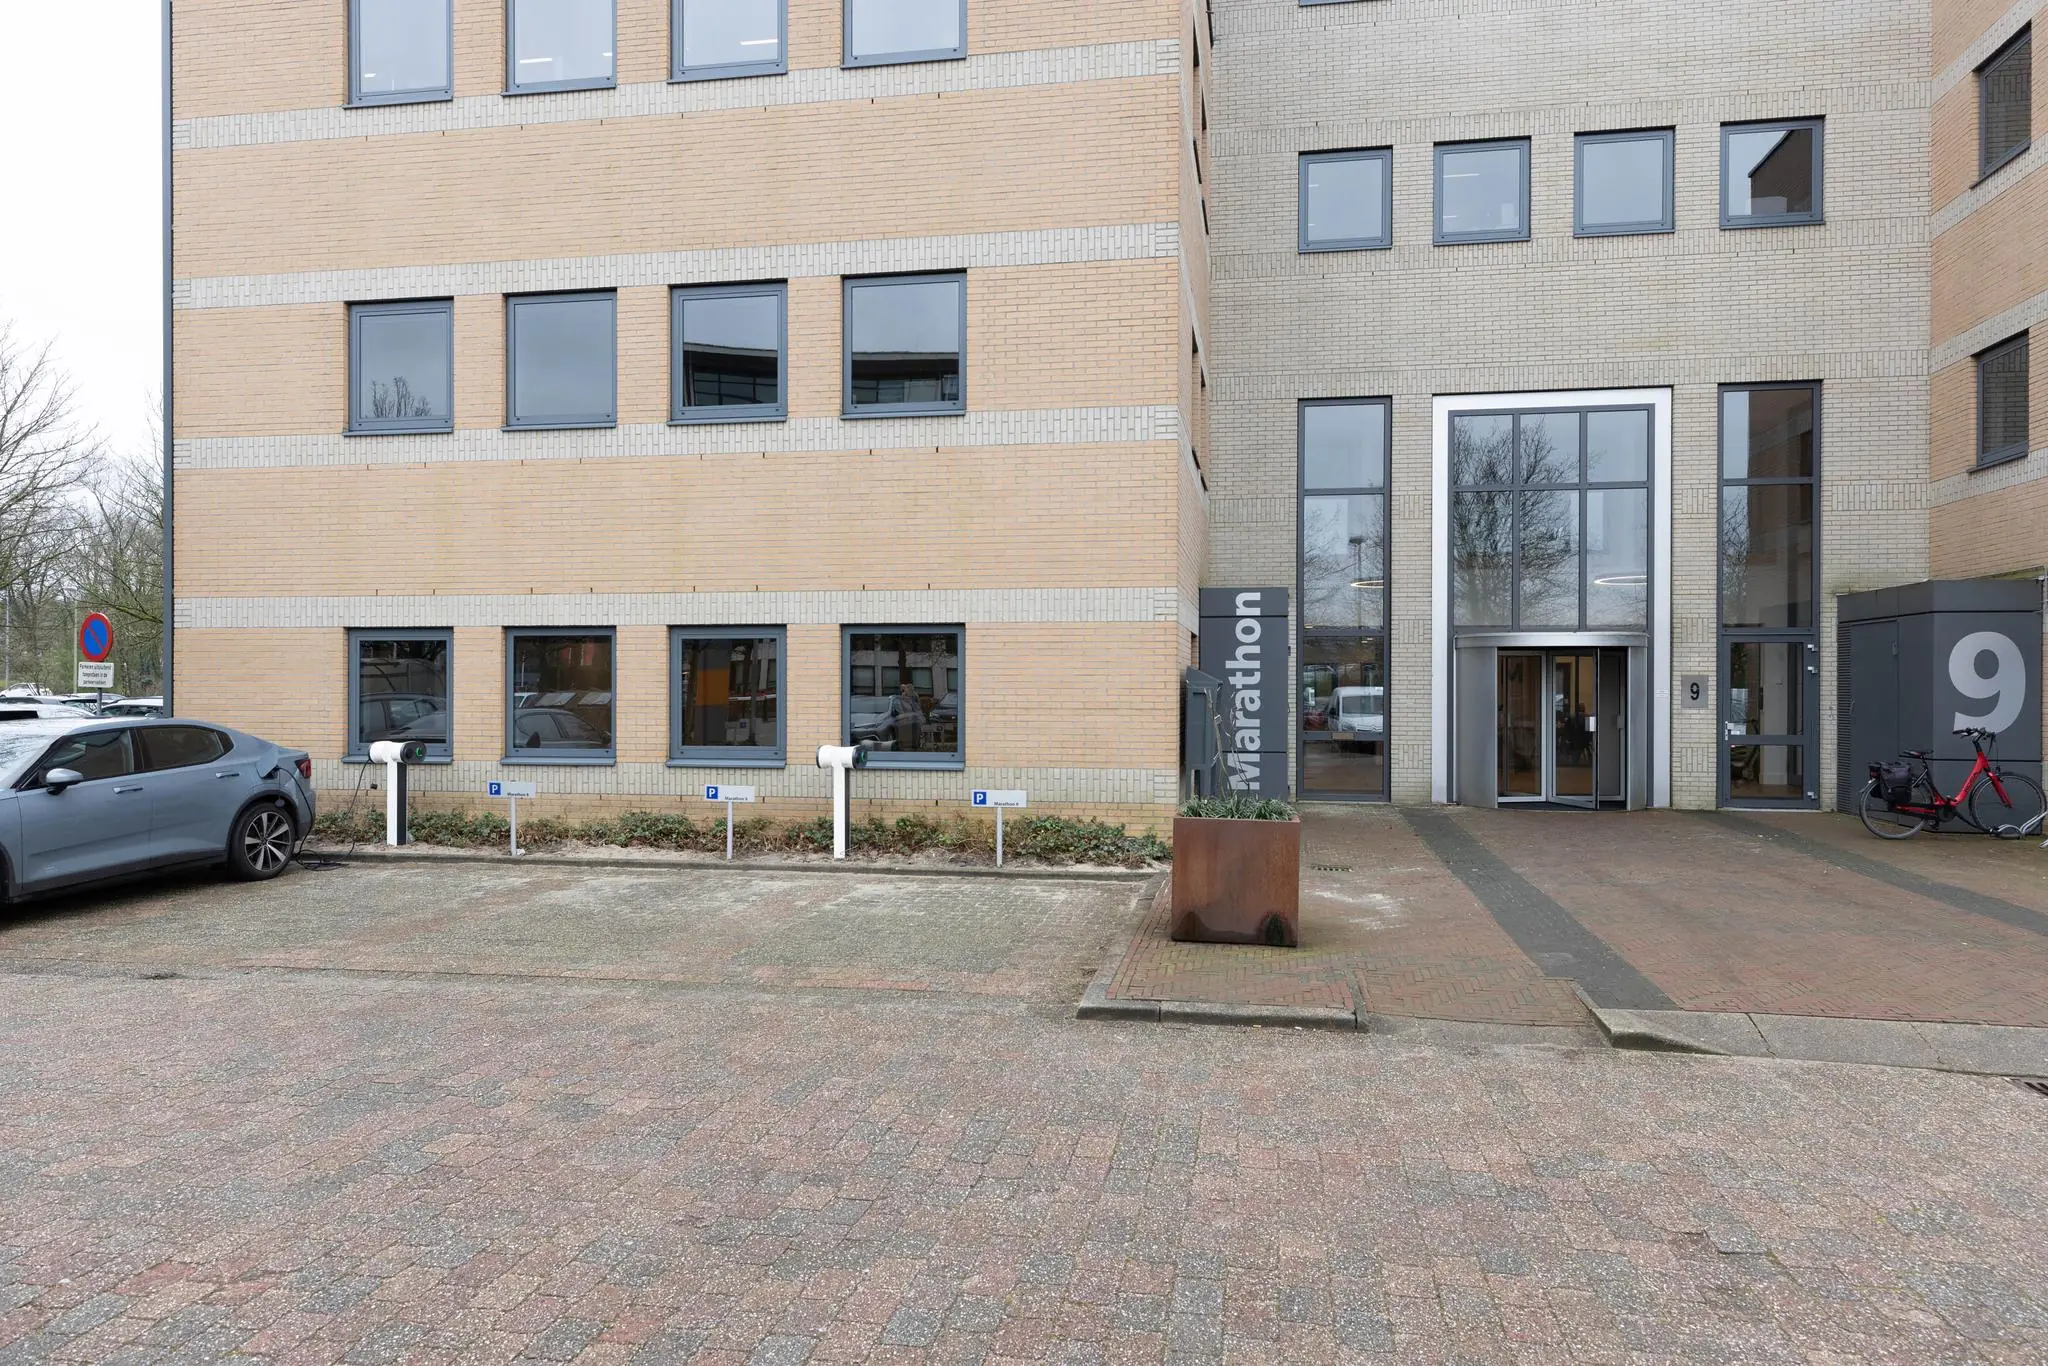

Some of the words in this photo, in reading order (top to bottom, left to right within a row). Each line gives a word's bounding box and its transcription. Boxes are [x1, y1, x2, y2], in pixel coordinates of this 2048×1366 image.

[1948, 631, 2026, 736] 9
[1225, 592, 1262, 790] Marathon
[1690, 682, 1700, 701] 9
[492, 784, 498, 793] P
[709, 788, 716, 798] P
[976, 793, 984, 803] P
